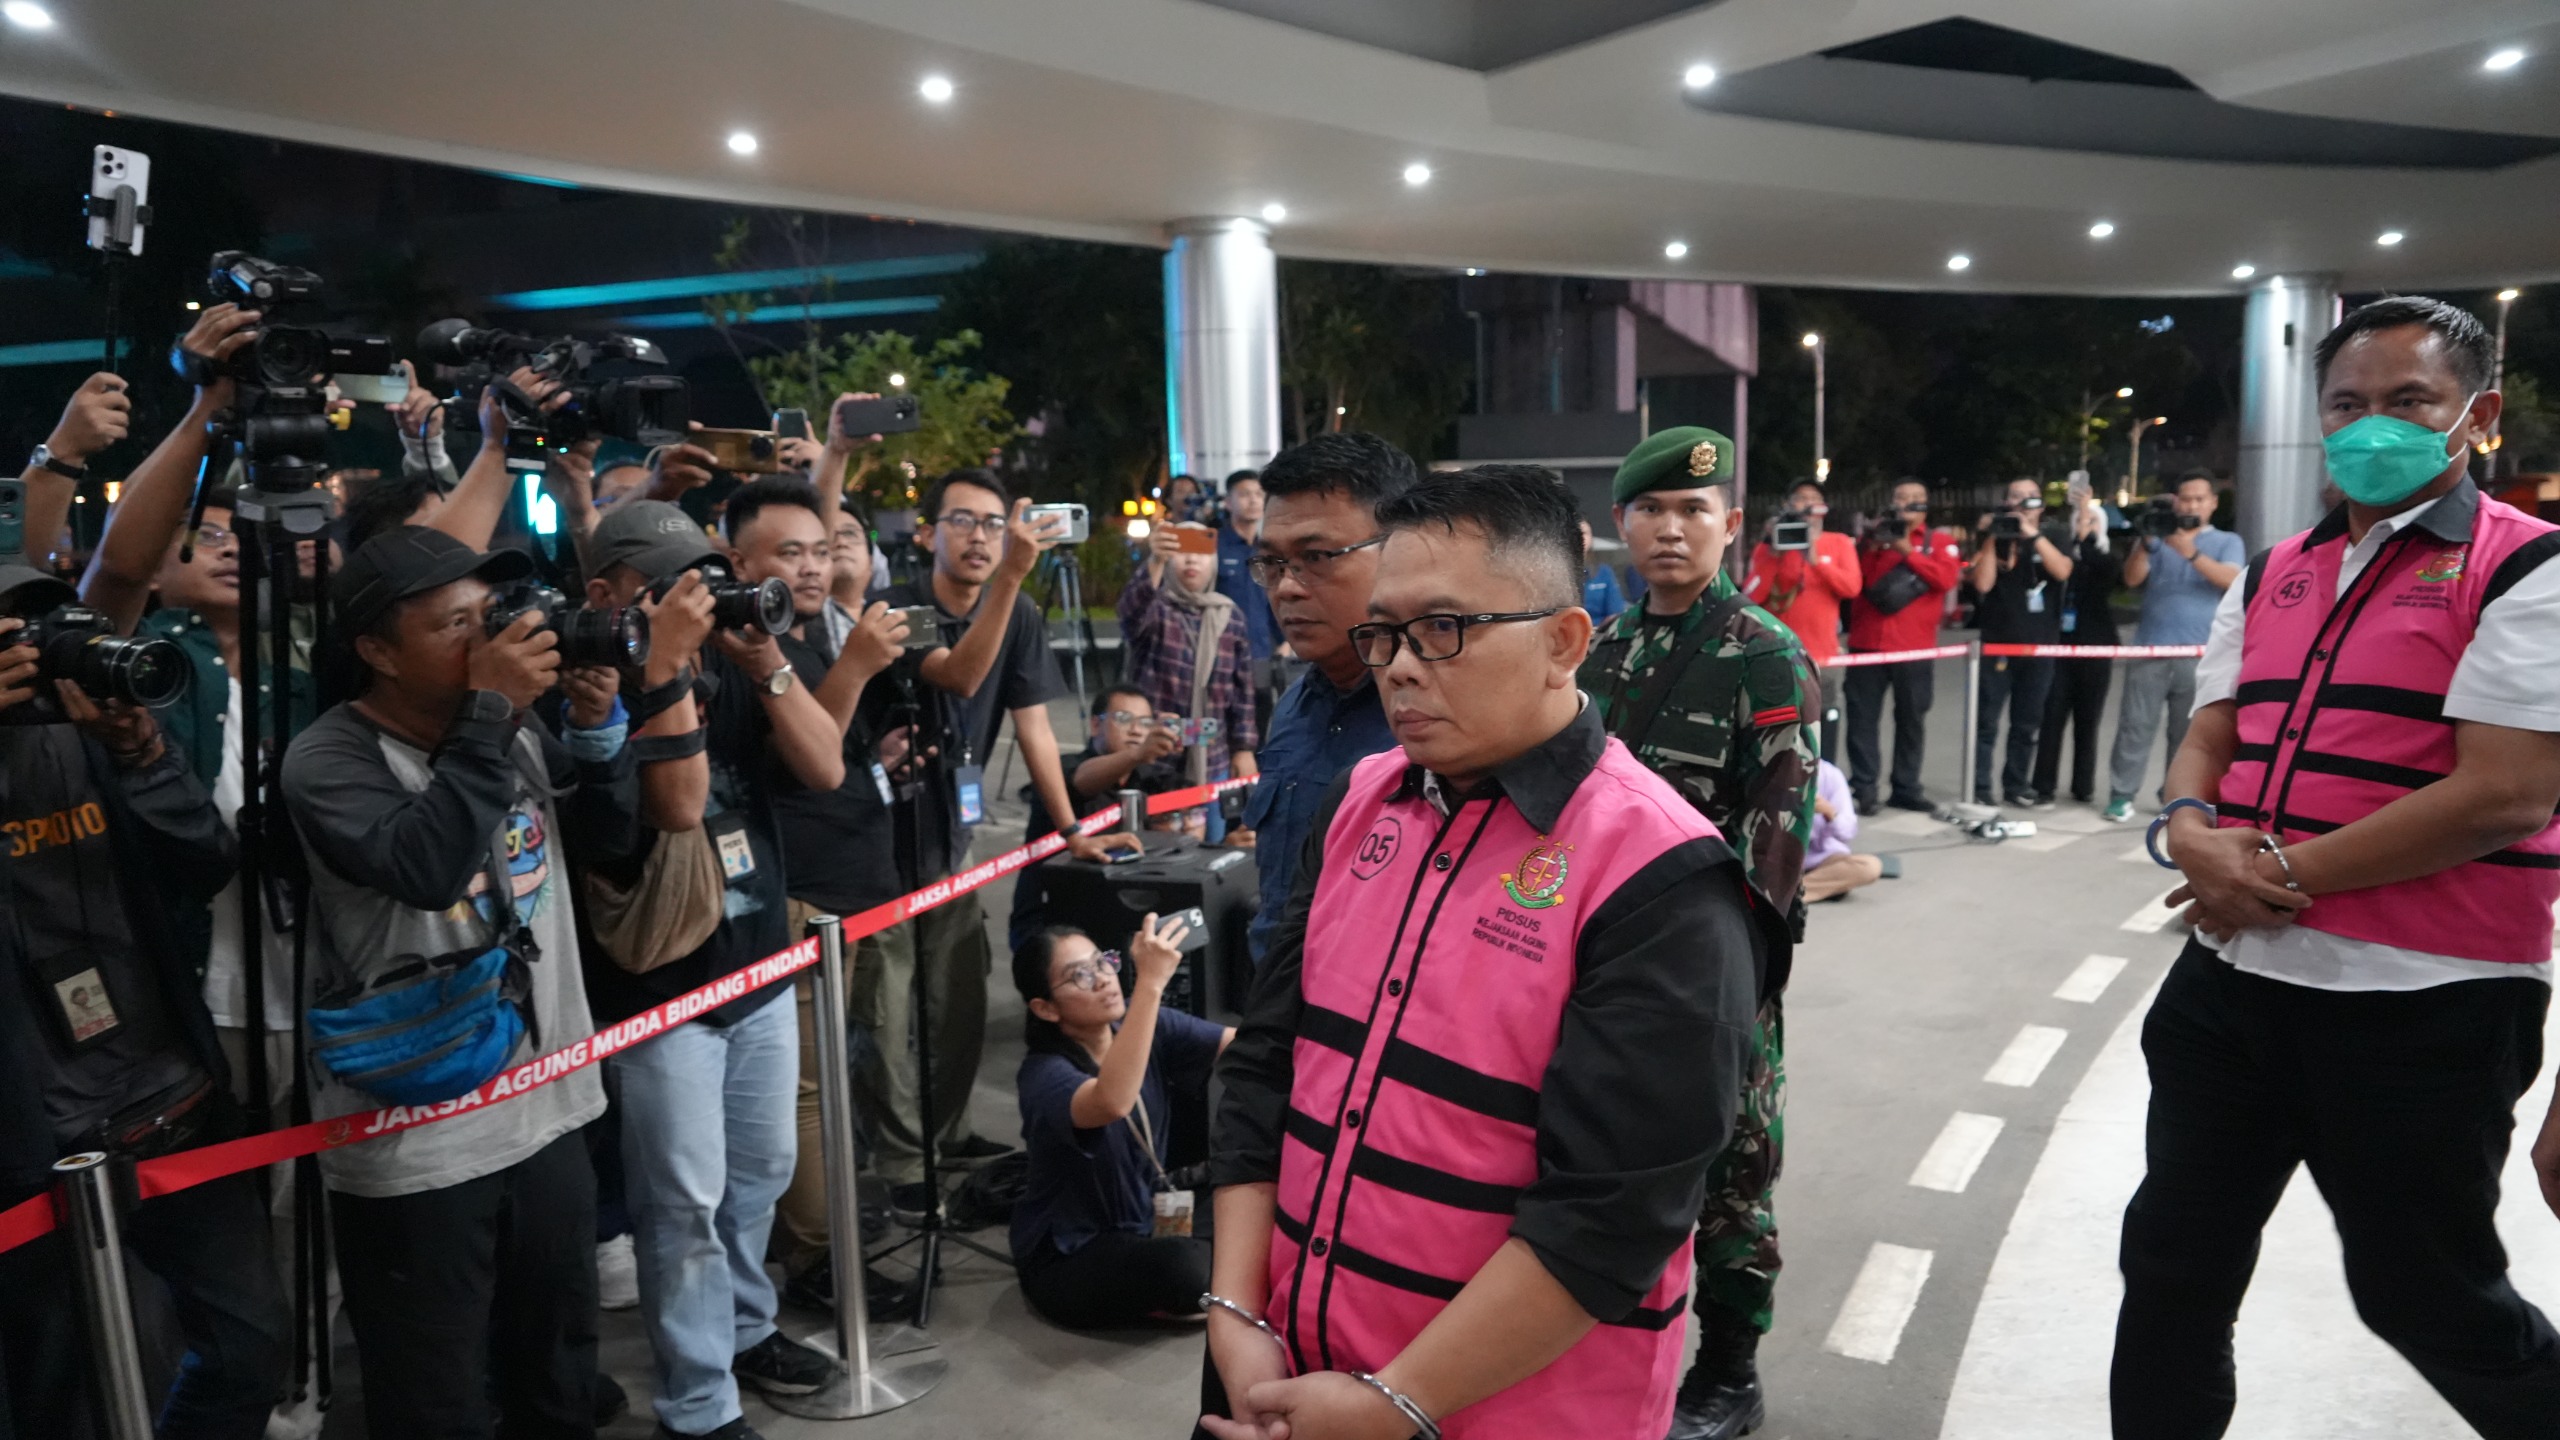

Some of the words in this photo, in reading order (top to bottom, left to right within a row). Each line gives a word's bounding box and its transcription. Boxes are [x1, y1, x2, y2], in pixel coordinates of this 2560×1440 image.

[2280, 579, 2309, 600] 45
[1359, 833, 1395, 864] 05
[908, 884, 951, 914] JAKSA
[952, 862, 996, 893] AGUNG
[1496, 907, 1541, 932] PIDSUS
[489, 1041, 588, 1100] AGUNG
[592, 1014, 662, 1058] MUDA
[666, 974, 745, 1025] BIDANG
[749, 939, 818, 987] TINDAK
